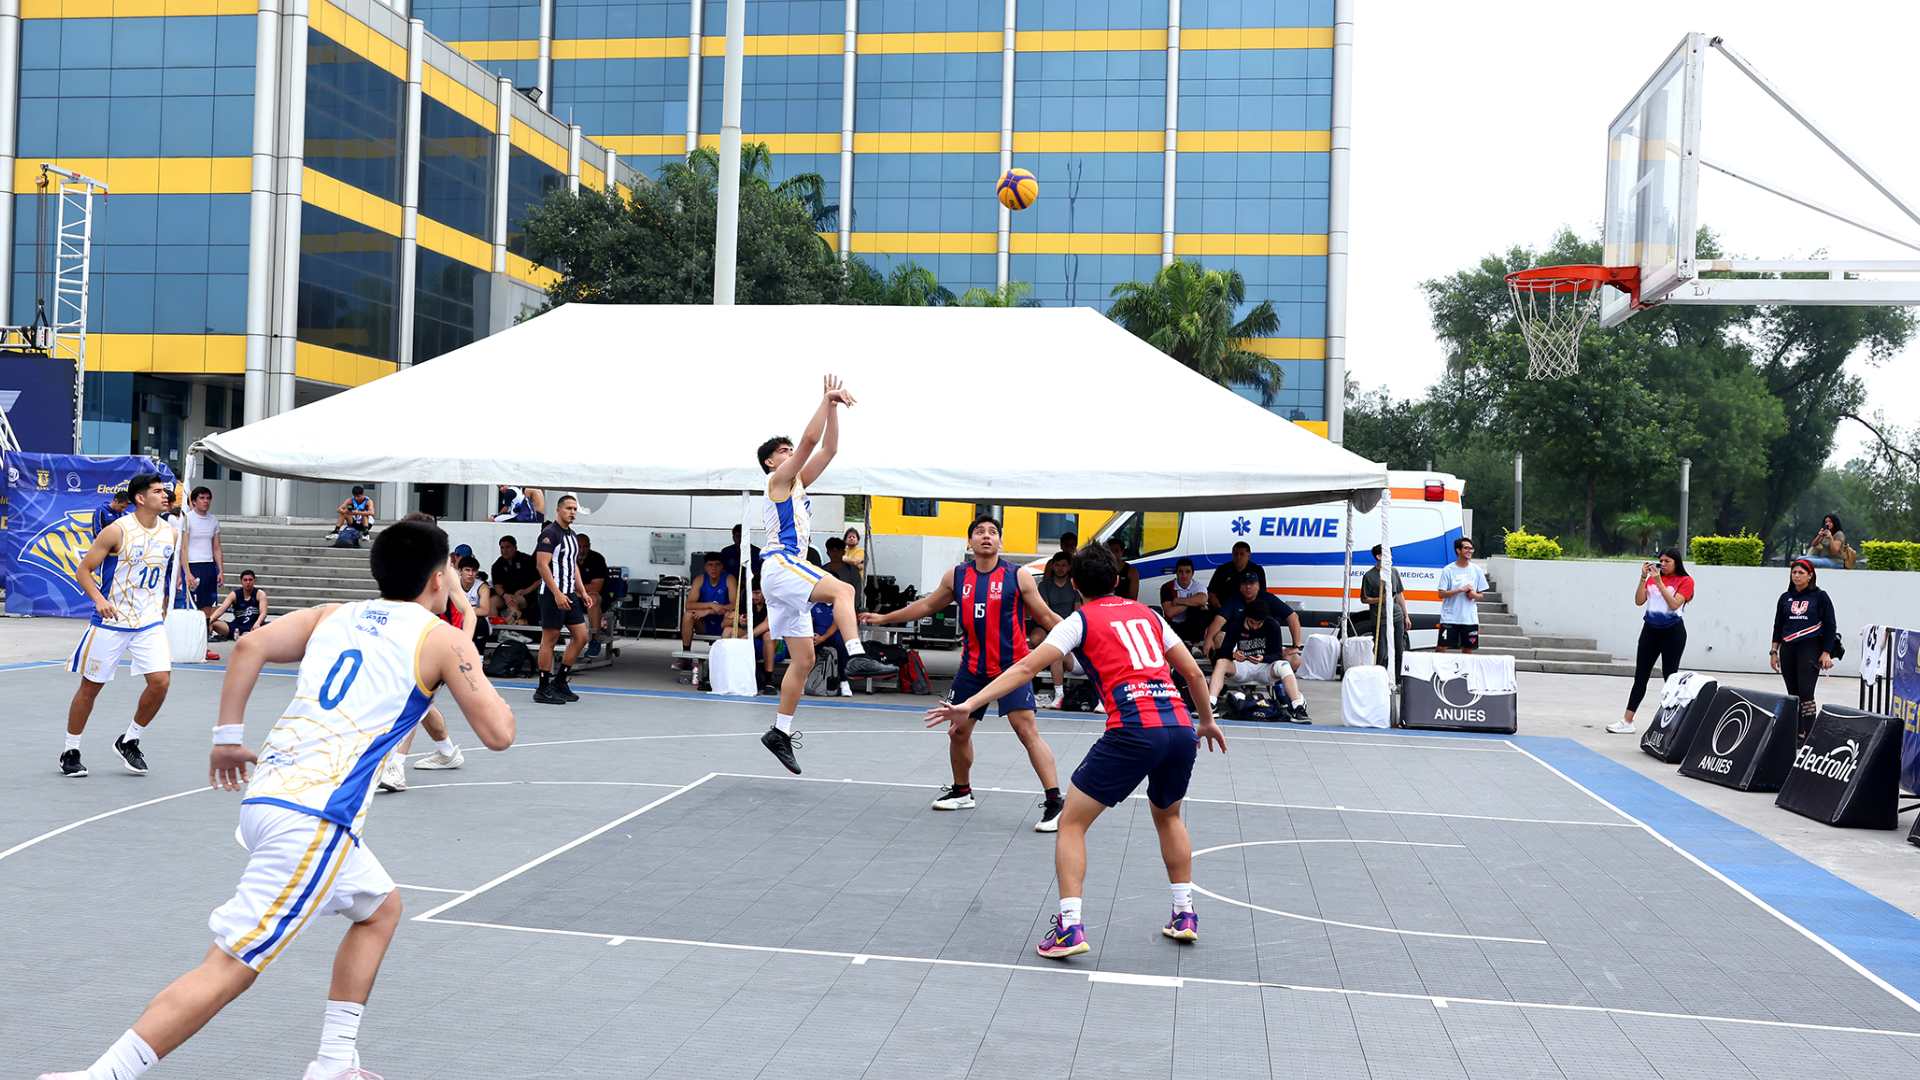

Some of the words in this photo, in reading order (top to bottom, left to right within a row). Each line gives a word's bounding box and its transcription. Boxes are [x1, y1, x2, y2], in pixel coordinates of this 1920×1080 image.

[1259, 516, 1339, 538] EMME
[139, 566, 160, 589] 10
[974, 603, 986, 619] 15
[1110, 617, 1166, 671] 10
[318, 649, 363, 710] 0
[1433, 707, 1487, 722] ANUIES
[1698, 755, 1733, 775] ANUIES
[1793, 744, 1858, 783] Electrolit
